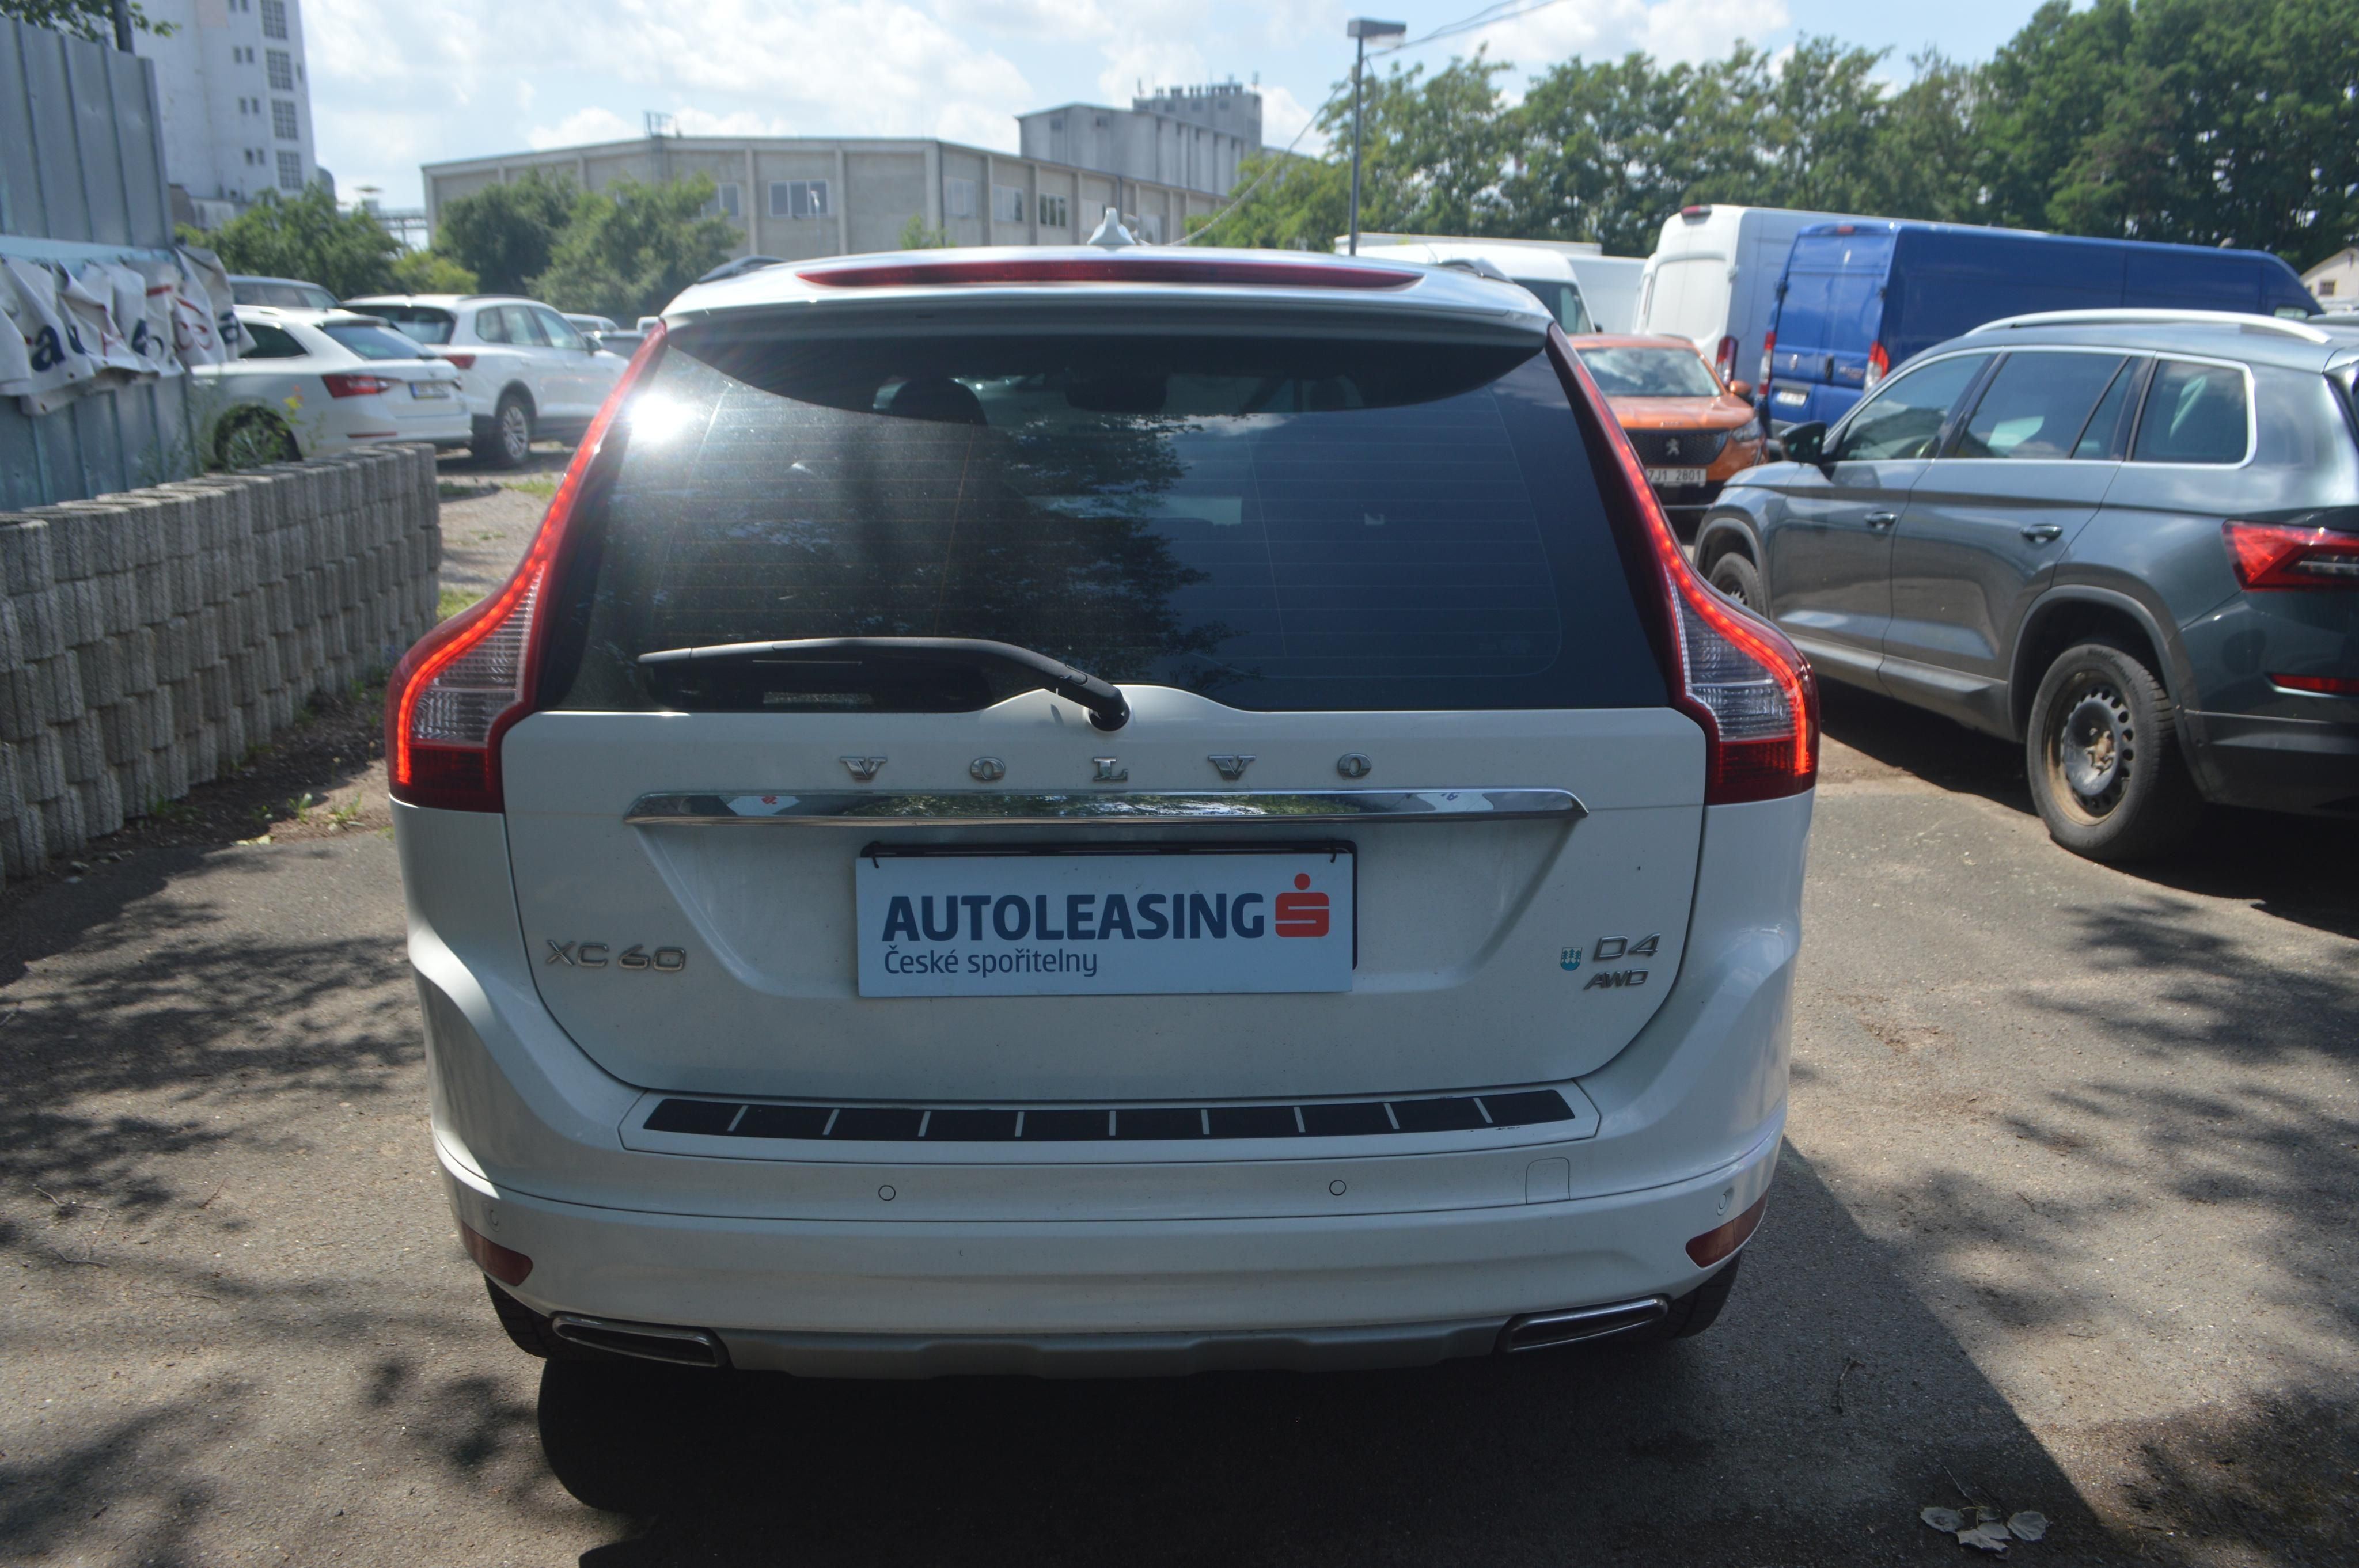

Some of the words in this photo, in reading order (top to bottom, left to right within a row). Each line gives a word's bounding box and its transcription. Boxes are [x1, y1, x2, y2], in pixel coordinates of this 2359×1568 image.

[1676, 469, 1701, 481] 2801
[839, 753, 1372, 783] VOLVO
[881, 892, 1265, 942] AUTOLEASING
[884, 945, 959, 974] České
[968, 948, 1097, 978] spořitelny
[1592, 932, 1661, 962] D4
[1583, 969, 1649, 991] AWD
